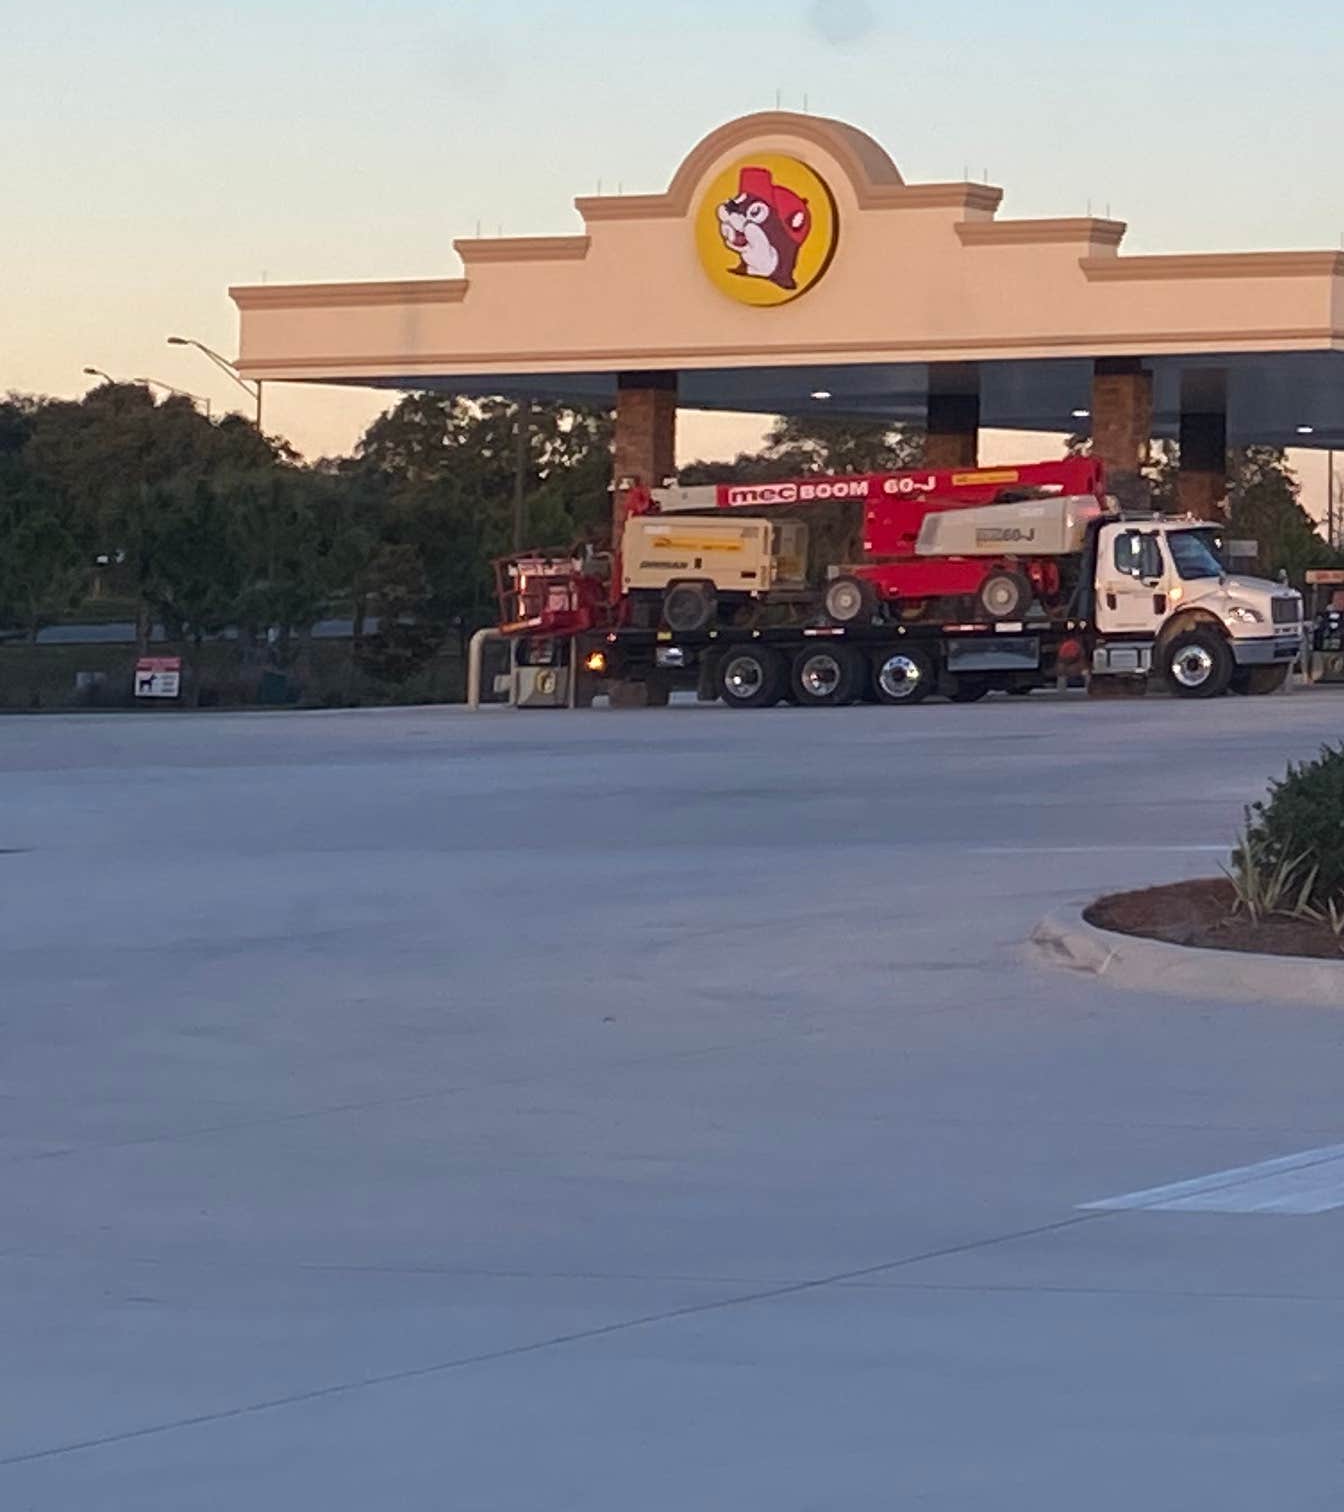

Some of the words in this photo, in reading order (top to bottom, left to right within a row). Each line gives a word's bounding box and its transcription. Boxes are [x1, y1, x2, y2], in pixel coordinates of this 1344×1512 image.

[731, 485, 796, 504] mec
[800, 481, 869, 499] BOOM
[884, 476, 937, 493] 60-J
